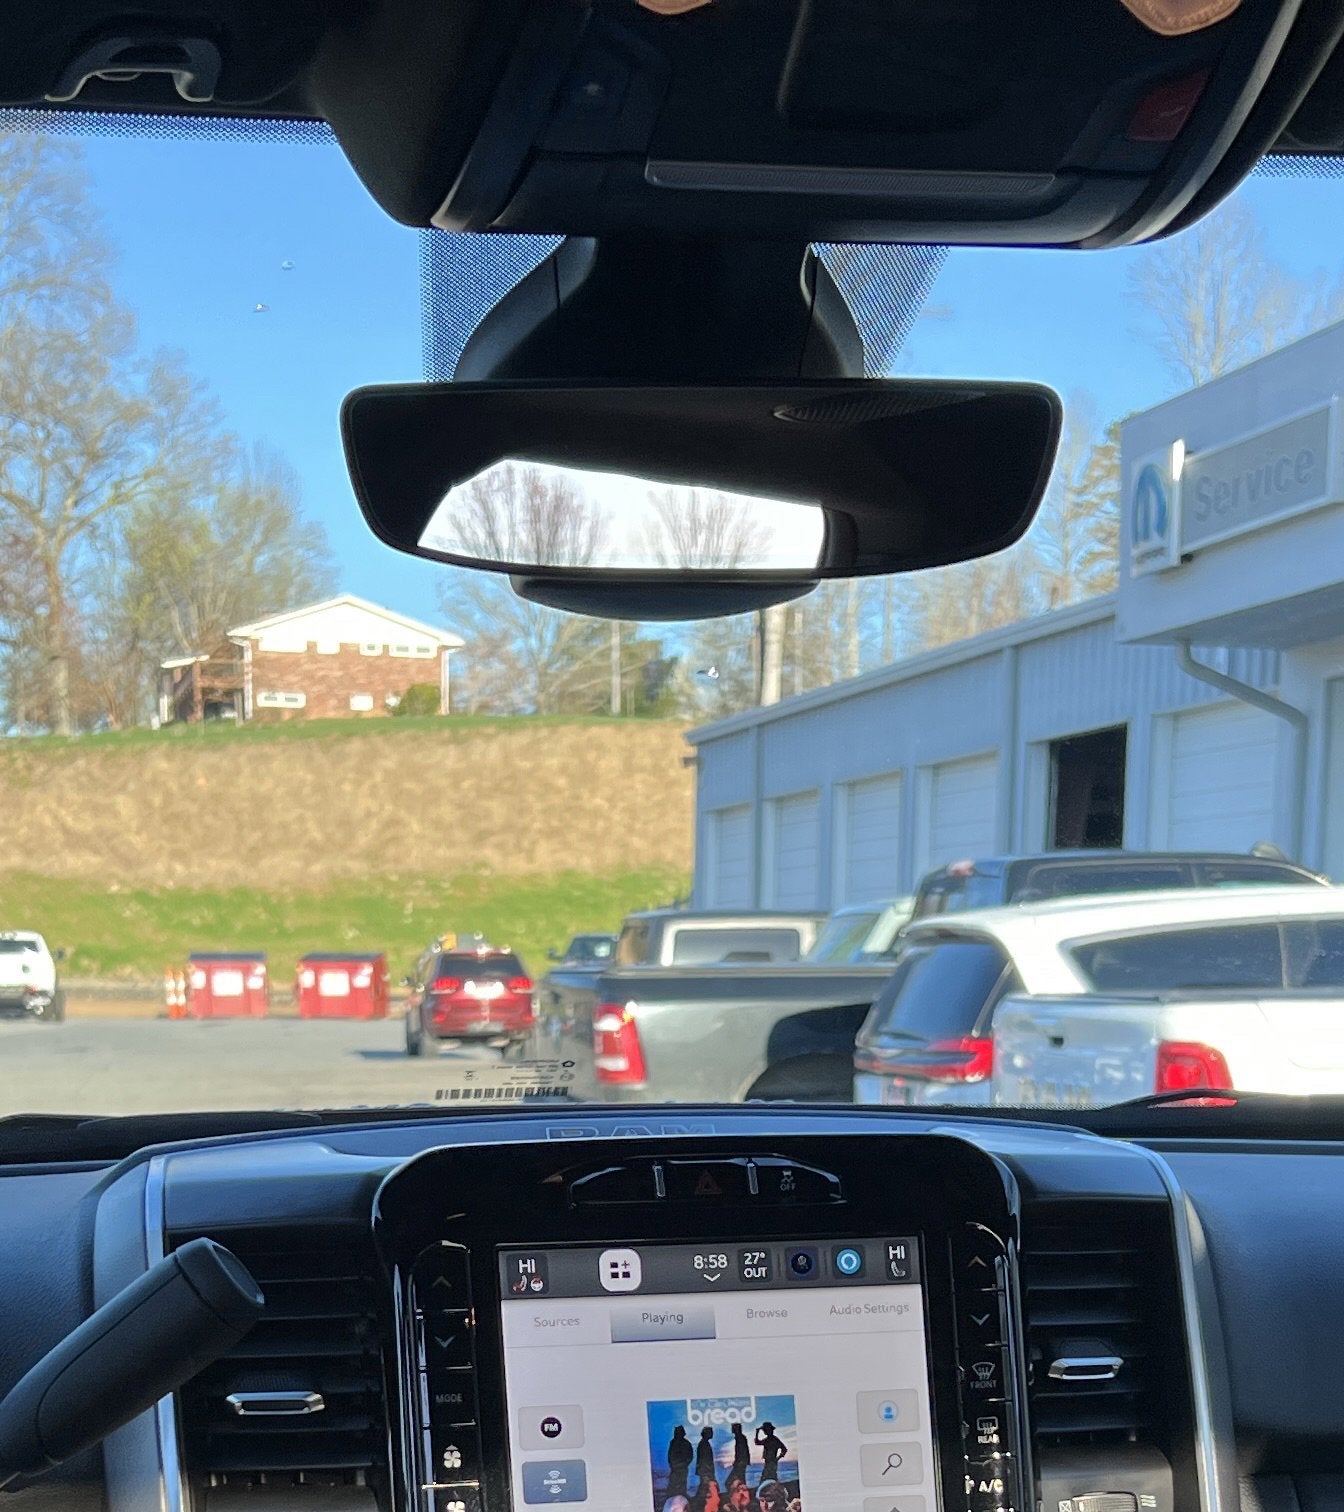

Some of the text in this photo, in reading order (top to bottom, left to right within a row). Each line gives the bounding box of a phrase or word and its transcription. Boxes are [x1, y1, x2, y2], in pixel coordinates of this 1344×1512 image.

[1195, 449, 1314, 522] Service
[743, 1252, 766, 1265] 27°
[889, 1246, 905, 1259] HI
[518, 1259, 536, 1273] HI
[693, 1254, 728, 1269] 8:58
[744, 1266, 767, 1278] OUT
[746, 1308, 788, 1319] Browse
[830, 1303, 909, 1316] Audio Settings
[534, 1316, 580, 1327] Sources
[641, 1312, 684, 1325] Playing
[436, 1393, 463, 1403] MODE
[687, 1396, 756, 1425] bread
[544, 1423, 558, 1432] FM
[979, 1479, 1004, 1494] A/C
